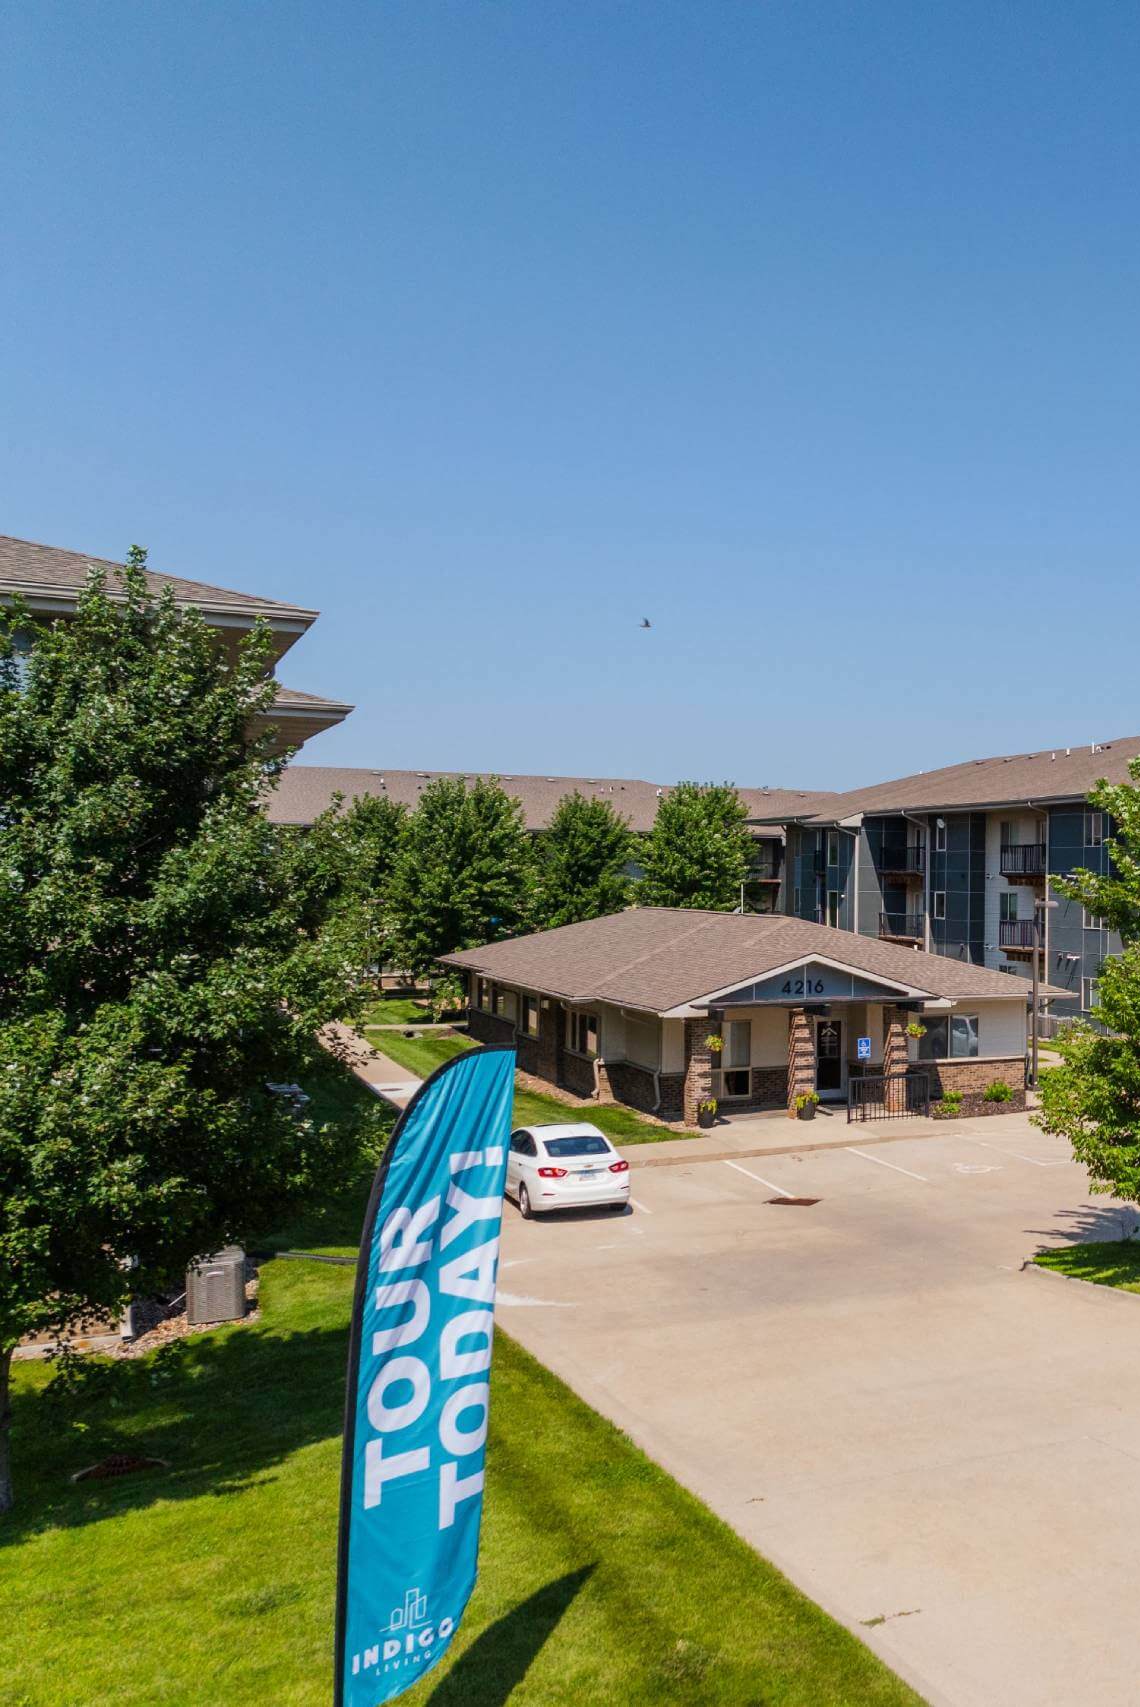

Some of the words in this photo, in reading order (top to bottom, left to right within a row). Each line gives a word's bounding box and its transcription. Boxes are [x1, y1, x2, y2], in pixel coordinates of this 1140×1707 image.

[781, 979, 825, 995] 4216
[363, 1194, 443, 1511] TOUR
[438, 1145, 504, 1531] TODAY!
[351, 1616, 454, 1676] INDIGO
[375, 1649, 432, 1676] LIVING
